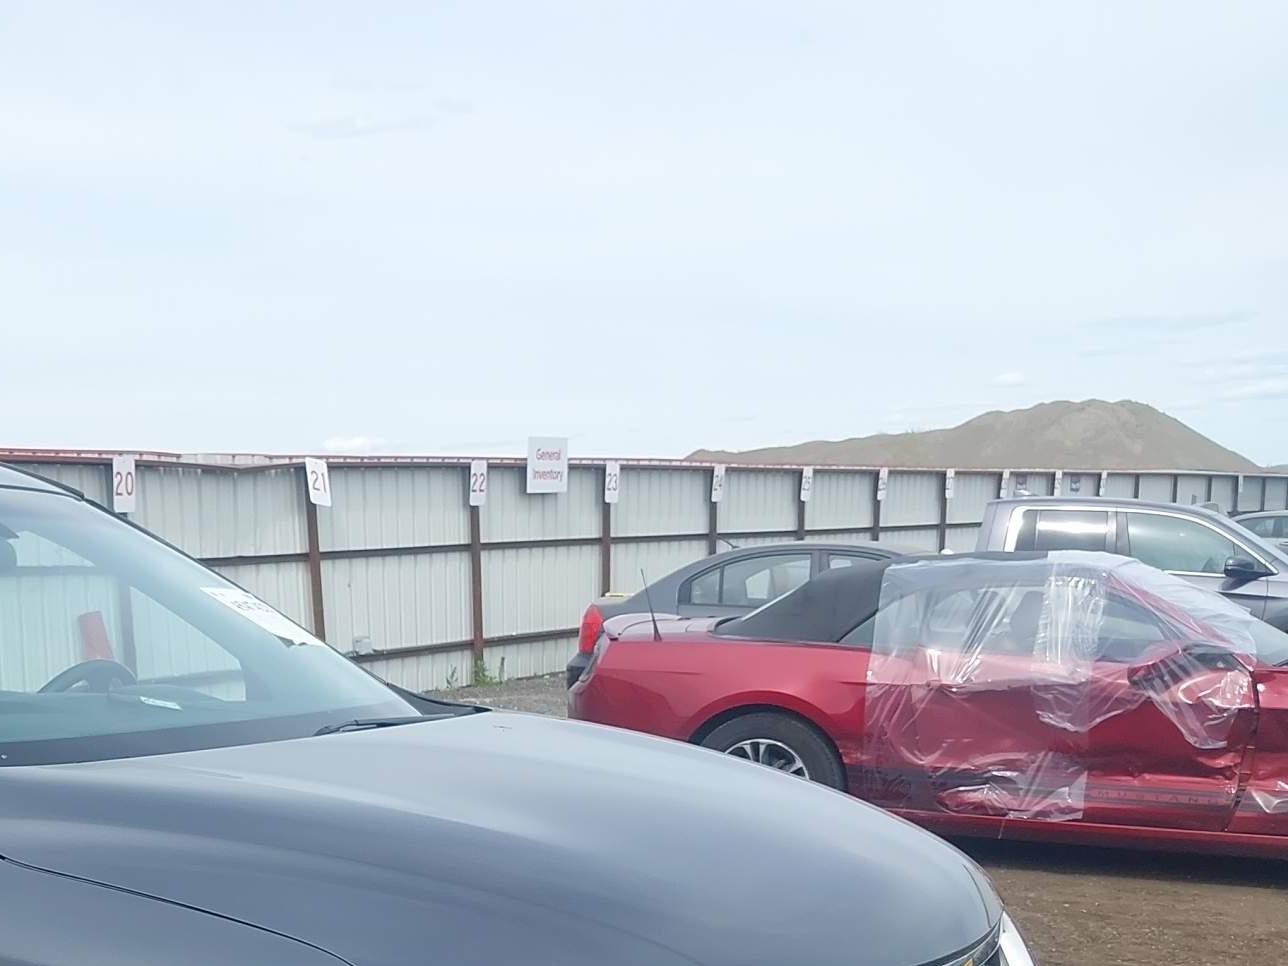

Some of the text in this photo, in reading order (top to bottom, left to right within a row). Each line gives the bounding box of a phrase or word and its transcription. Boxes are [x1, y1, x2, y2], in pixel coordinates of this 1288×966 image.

[535, 449, 561, 461] General
[114, 471, 135, 496] 20
[310, 470, 328, 493] 21
[470, 472, 486, 493] 22
[533, 469, 563, 482] Inventory
[606, 473, 618, 492] 23
